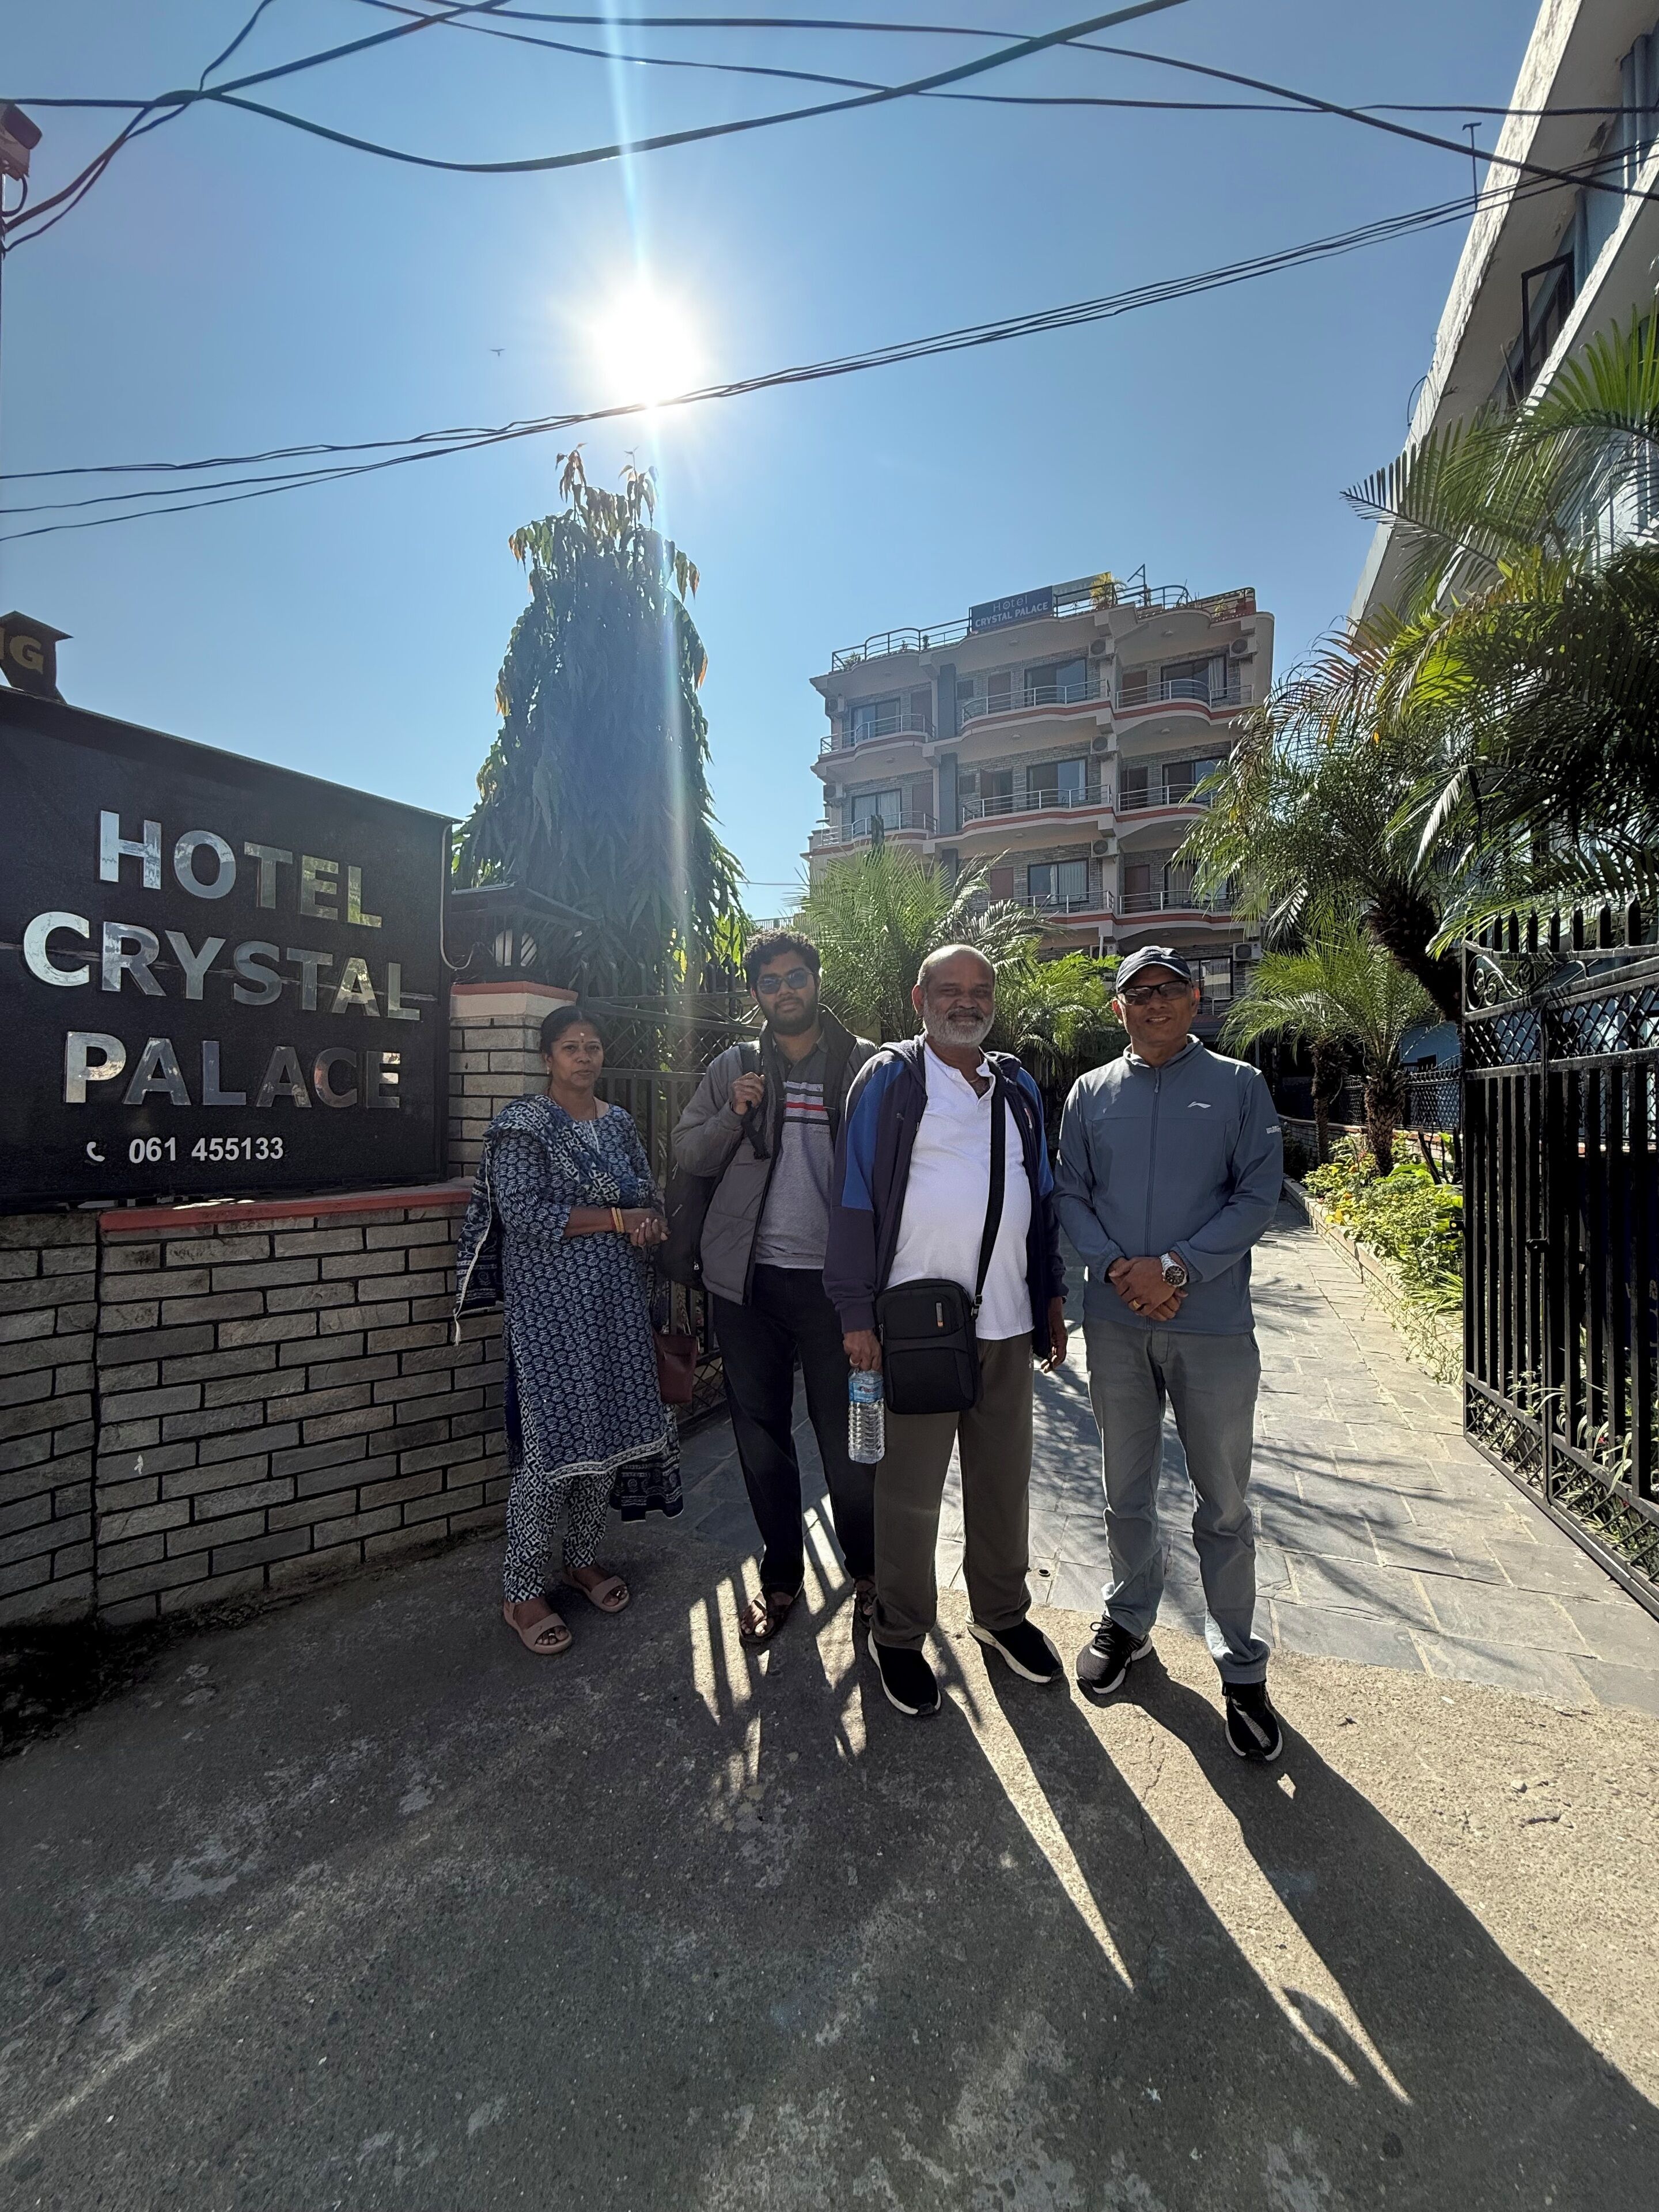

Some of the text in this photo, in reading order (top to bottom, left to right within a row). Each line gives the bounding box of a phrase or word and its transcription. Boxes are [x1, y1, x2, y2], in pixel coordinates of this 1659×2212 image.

[975, 601, 1048, 627] CRYSTAL PALACE
[993, 594, 1028, 612] Hotel
[0, 626, 44, 675] G
[99, 810, 382, 928] HOTEL
[22, 911, 421, 1021] CRYSTAL
[63, 1031, 401, 1109] PALACE
[128, 1137, 283, 1163] 061 455133
